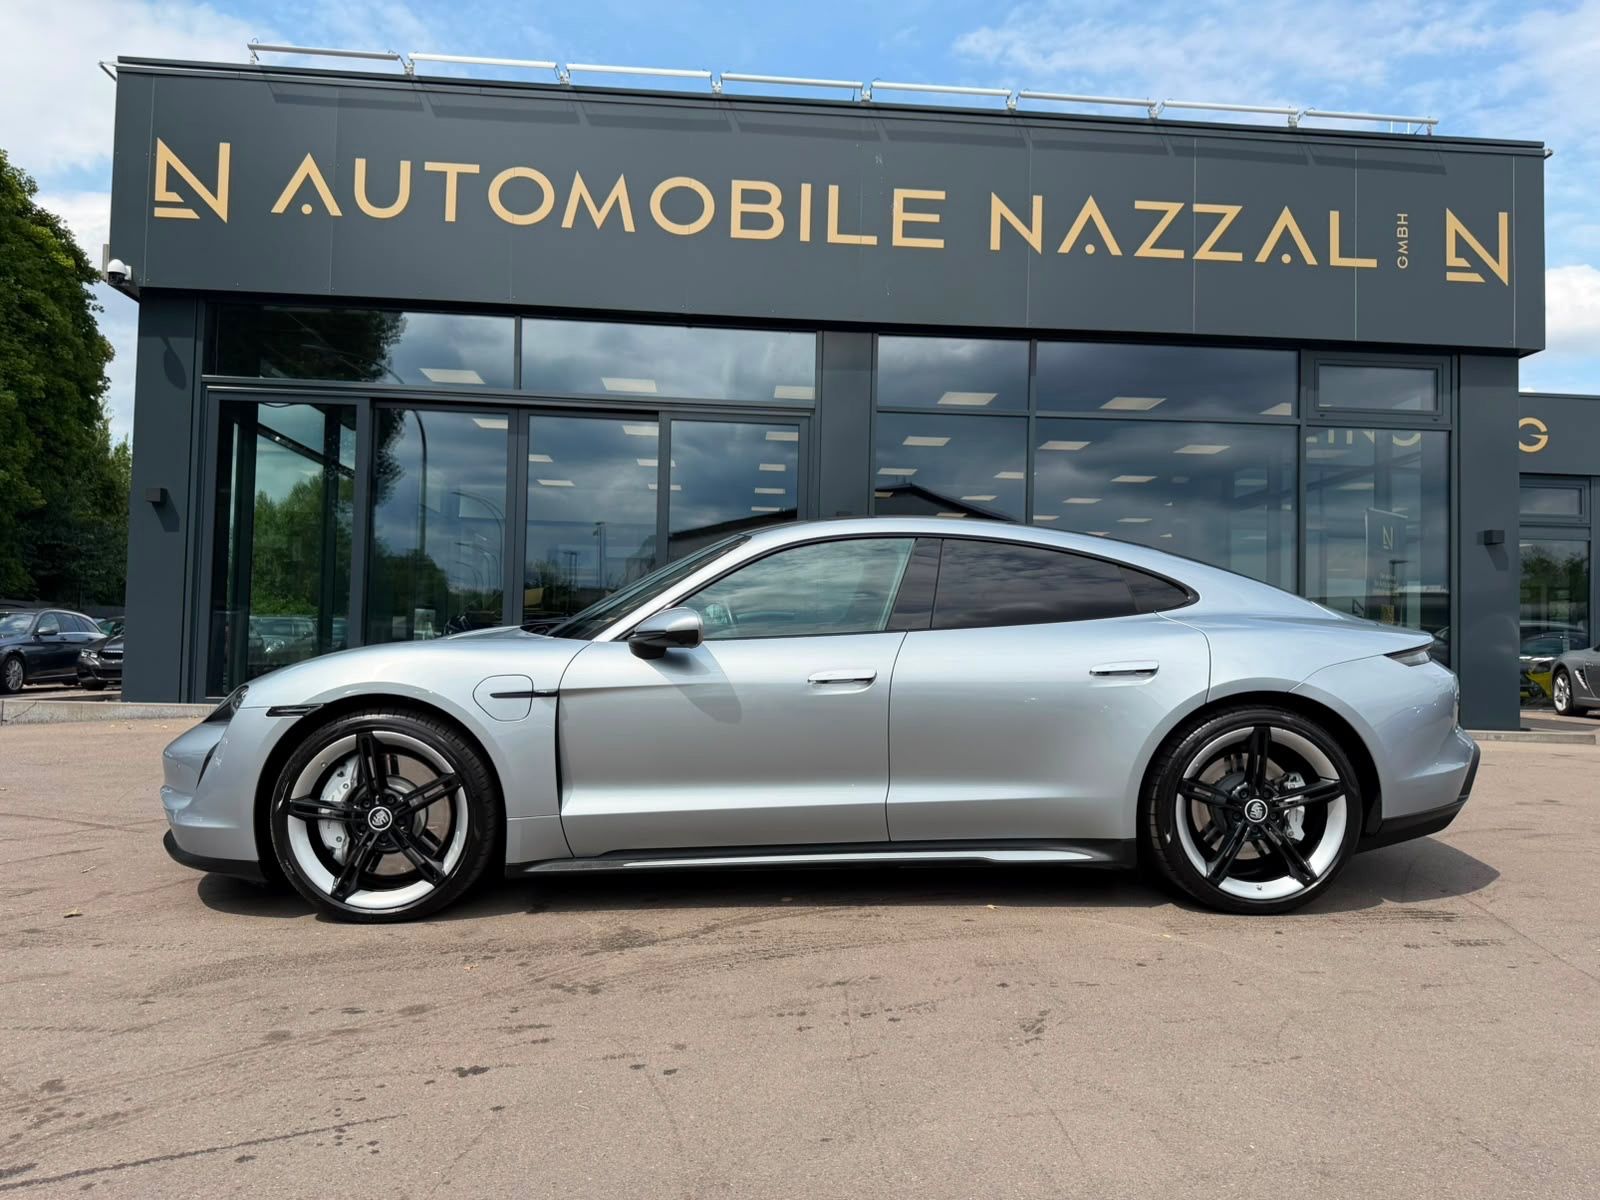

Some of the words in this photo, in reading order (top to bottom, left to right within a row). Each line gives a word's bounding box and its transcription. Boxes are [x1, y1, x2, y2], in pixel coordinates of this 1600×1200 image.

[270, 152, 948, 250] AUTOMOBILE
[989, 192, 1378, 270] NAZZAL
[1396, 213, 1409, 269] GMBH
